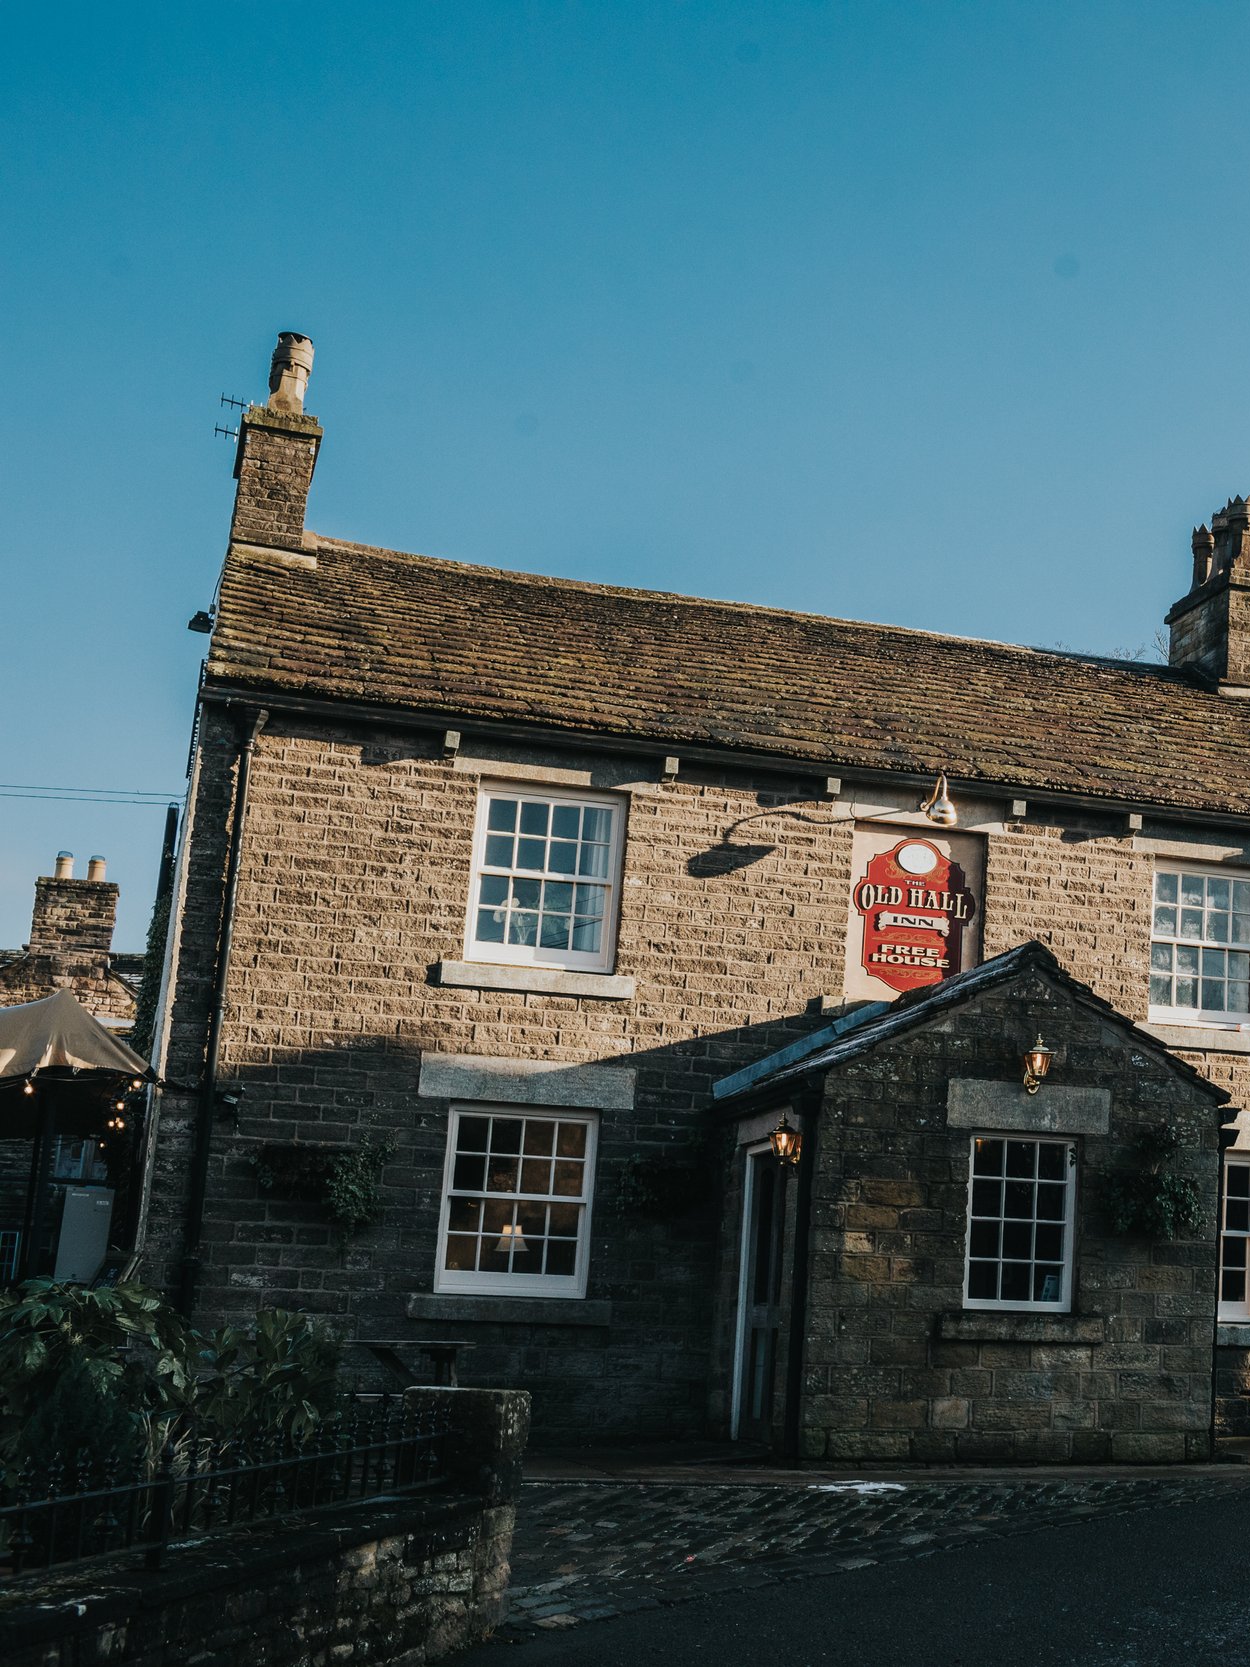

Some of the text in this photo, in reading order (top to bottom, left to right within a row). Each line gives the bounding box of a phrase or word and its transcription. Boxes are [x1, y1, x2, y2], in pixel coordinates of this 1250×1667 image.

[904, 879, 926, 887] THE
[861, 883, 968, 919] OLD HALL
[893, 916, 934, 927] INN
[881, 944, 940, 957] FREE
[872, 953, 950, 968] HOUSE
